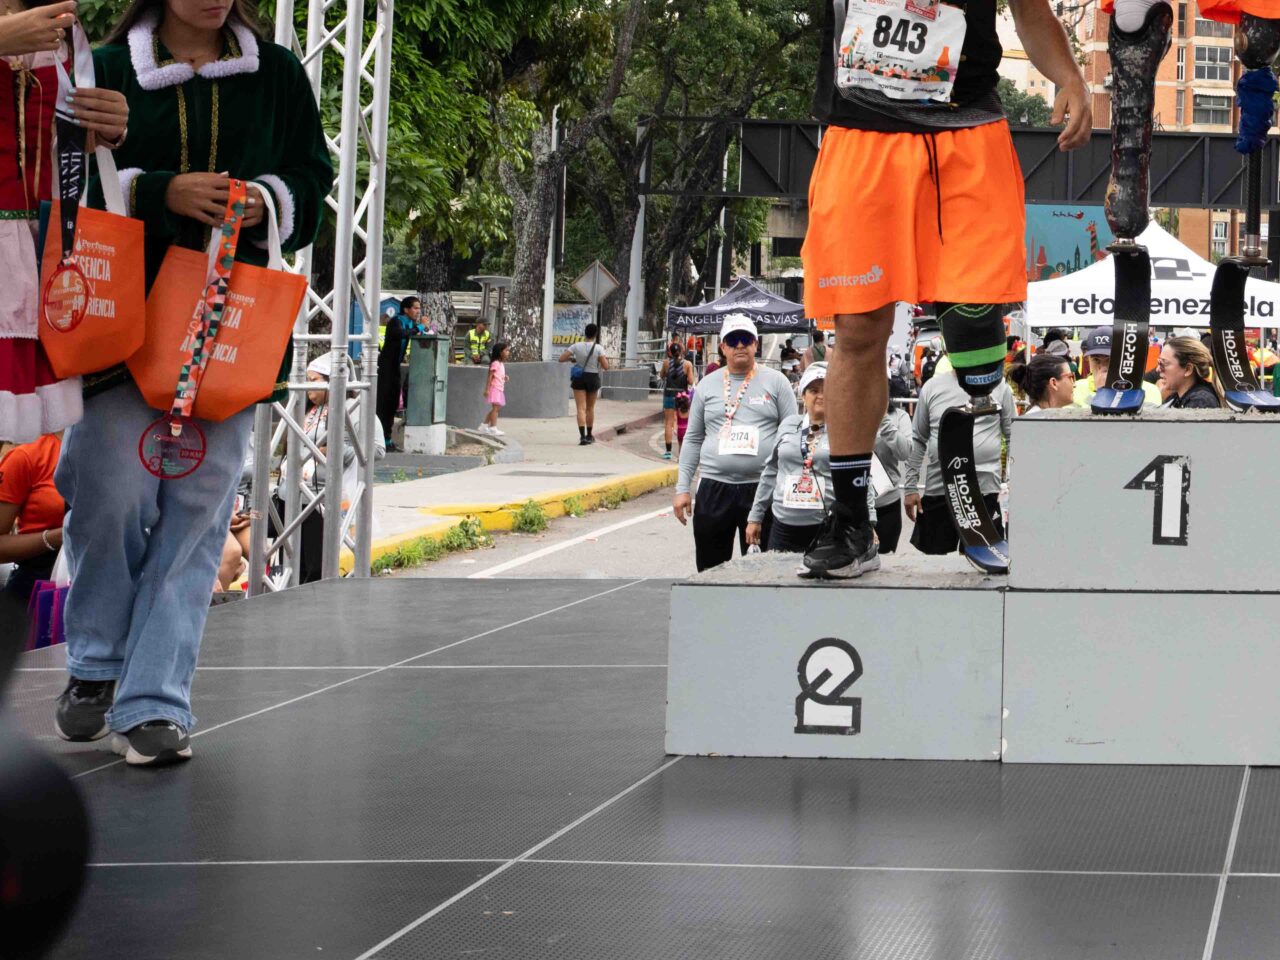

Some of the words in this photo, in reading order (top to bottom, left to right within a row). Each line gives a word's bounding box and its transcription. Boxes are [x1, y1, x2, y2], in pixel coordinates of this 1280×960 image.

[872, 14, 928, 55] 843
[773, 312, 799, 325] VÍAS
[1122, 323, 1138, 375] HOPPER
[1224, 329, 1245, 379] HOPPER
[730, 431, 749, 441] 2174
[956, 473, 982, 528] HOPPER
[1123, 455, 1191, 546] 1
[794, 637, 863, 736] 2
